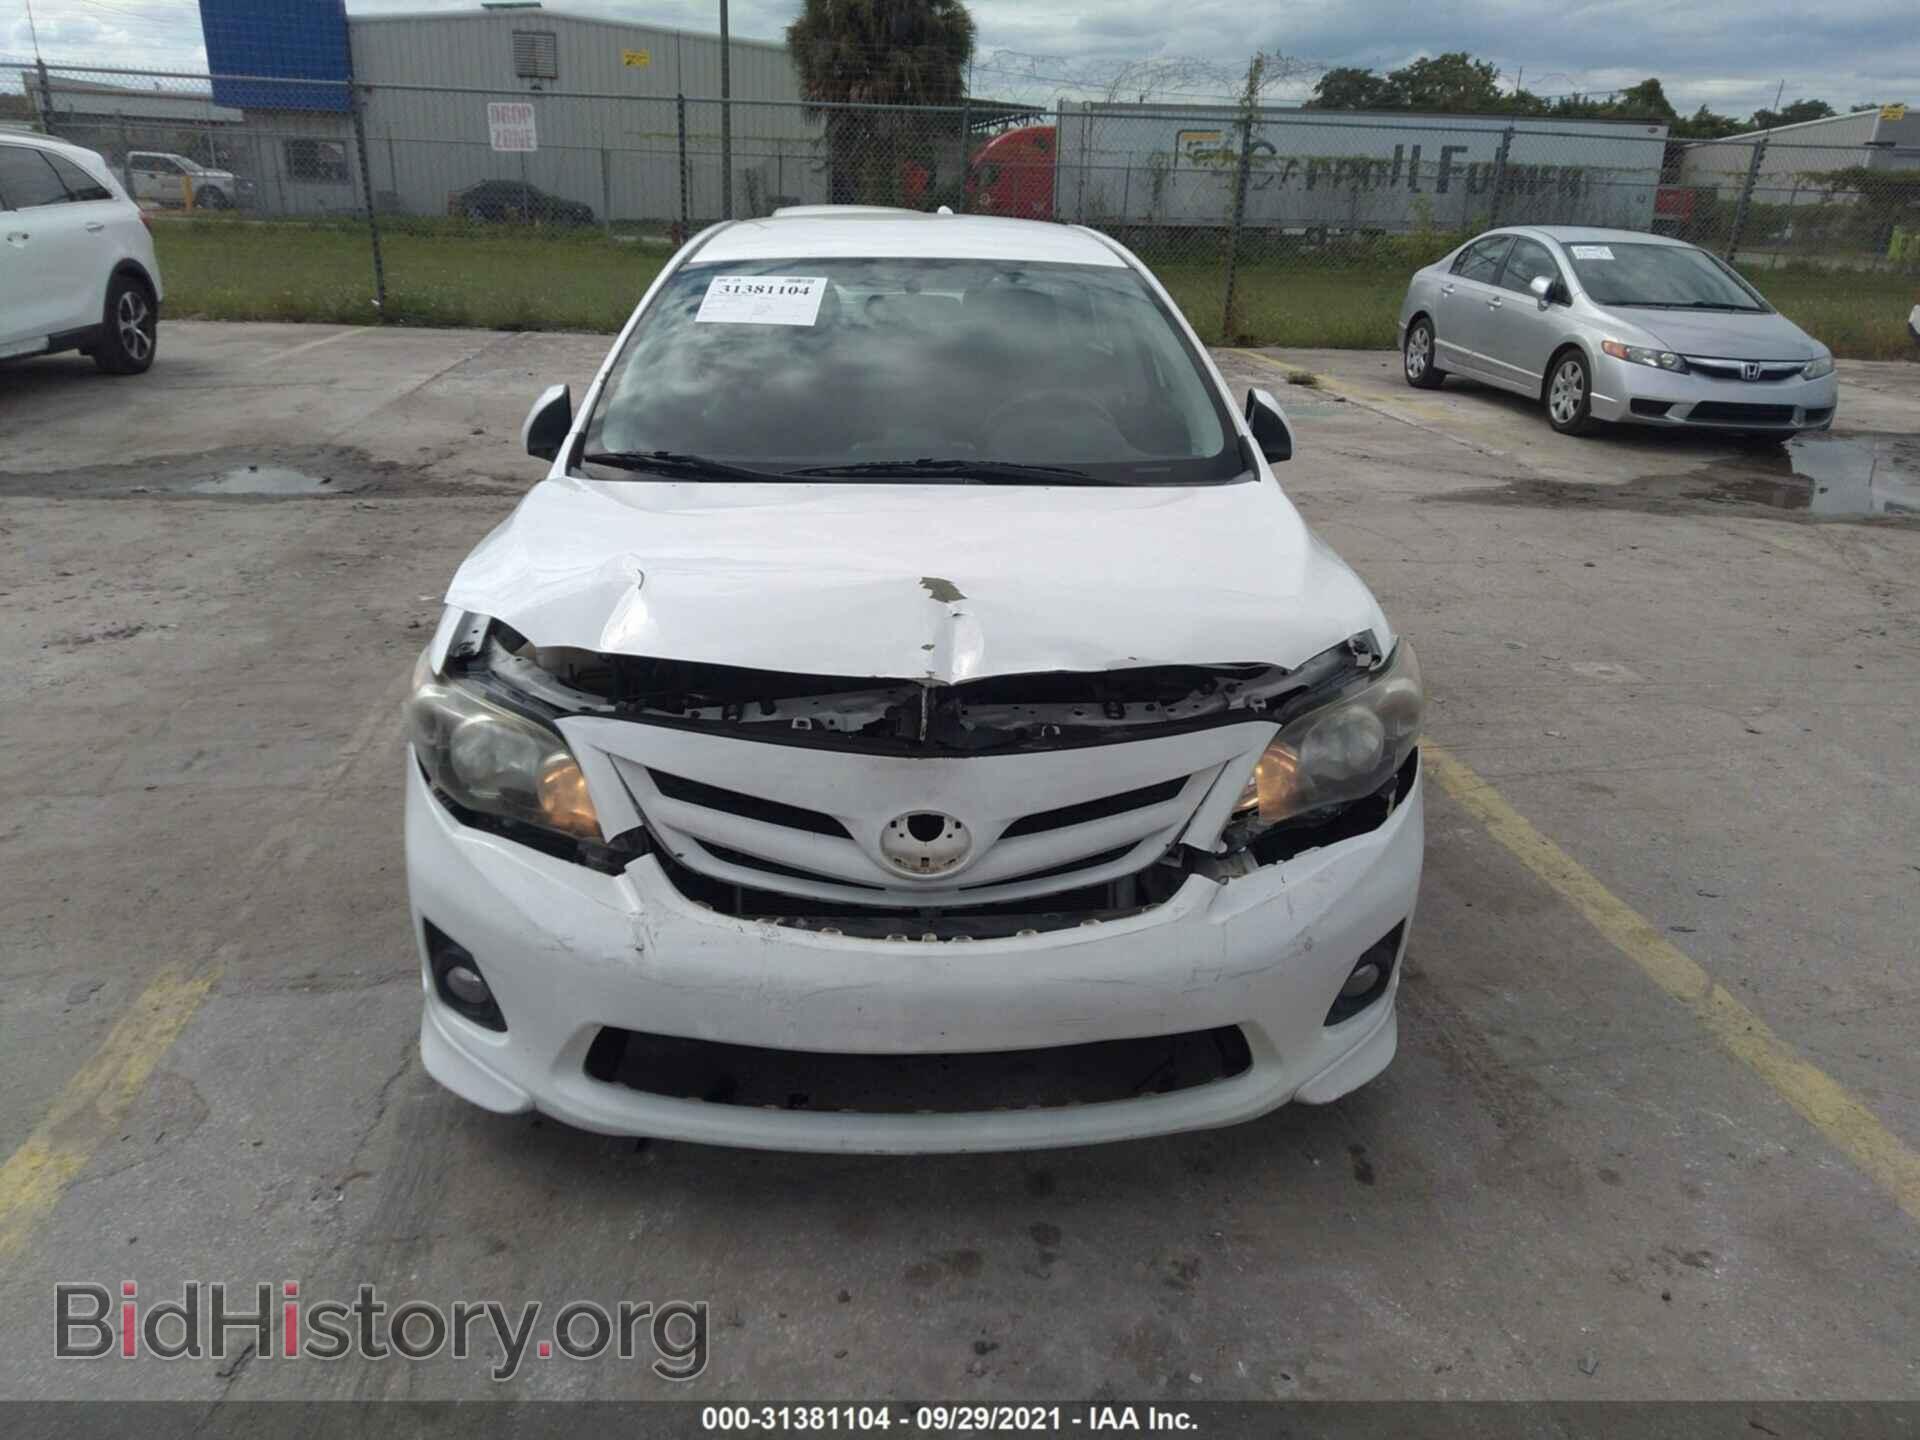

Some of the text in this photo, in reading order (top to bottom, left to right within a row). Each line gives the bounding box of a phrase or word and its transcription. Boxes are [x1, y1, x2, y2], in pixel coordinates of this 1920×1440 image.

[490, 105, 532, 124] DROP
[494, 129, 535, 148] ZONE
[720, 284, 811, 295] 31381104
